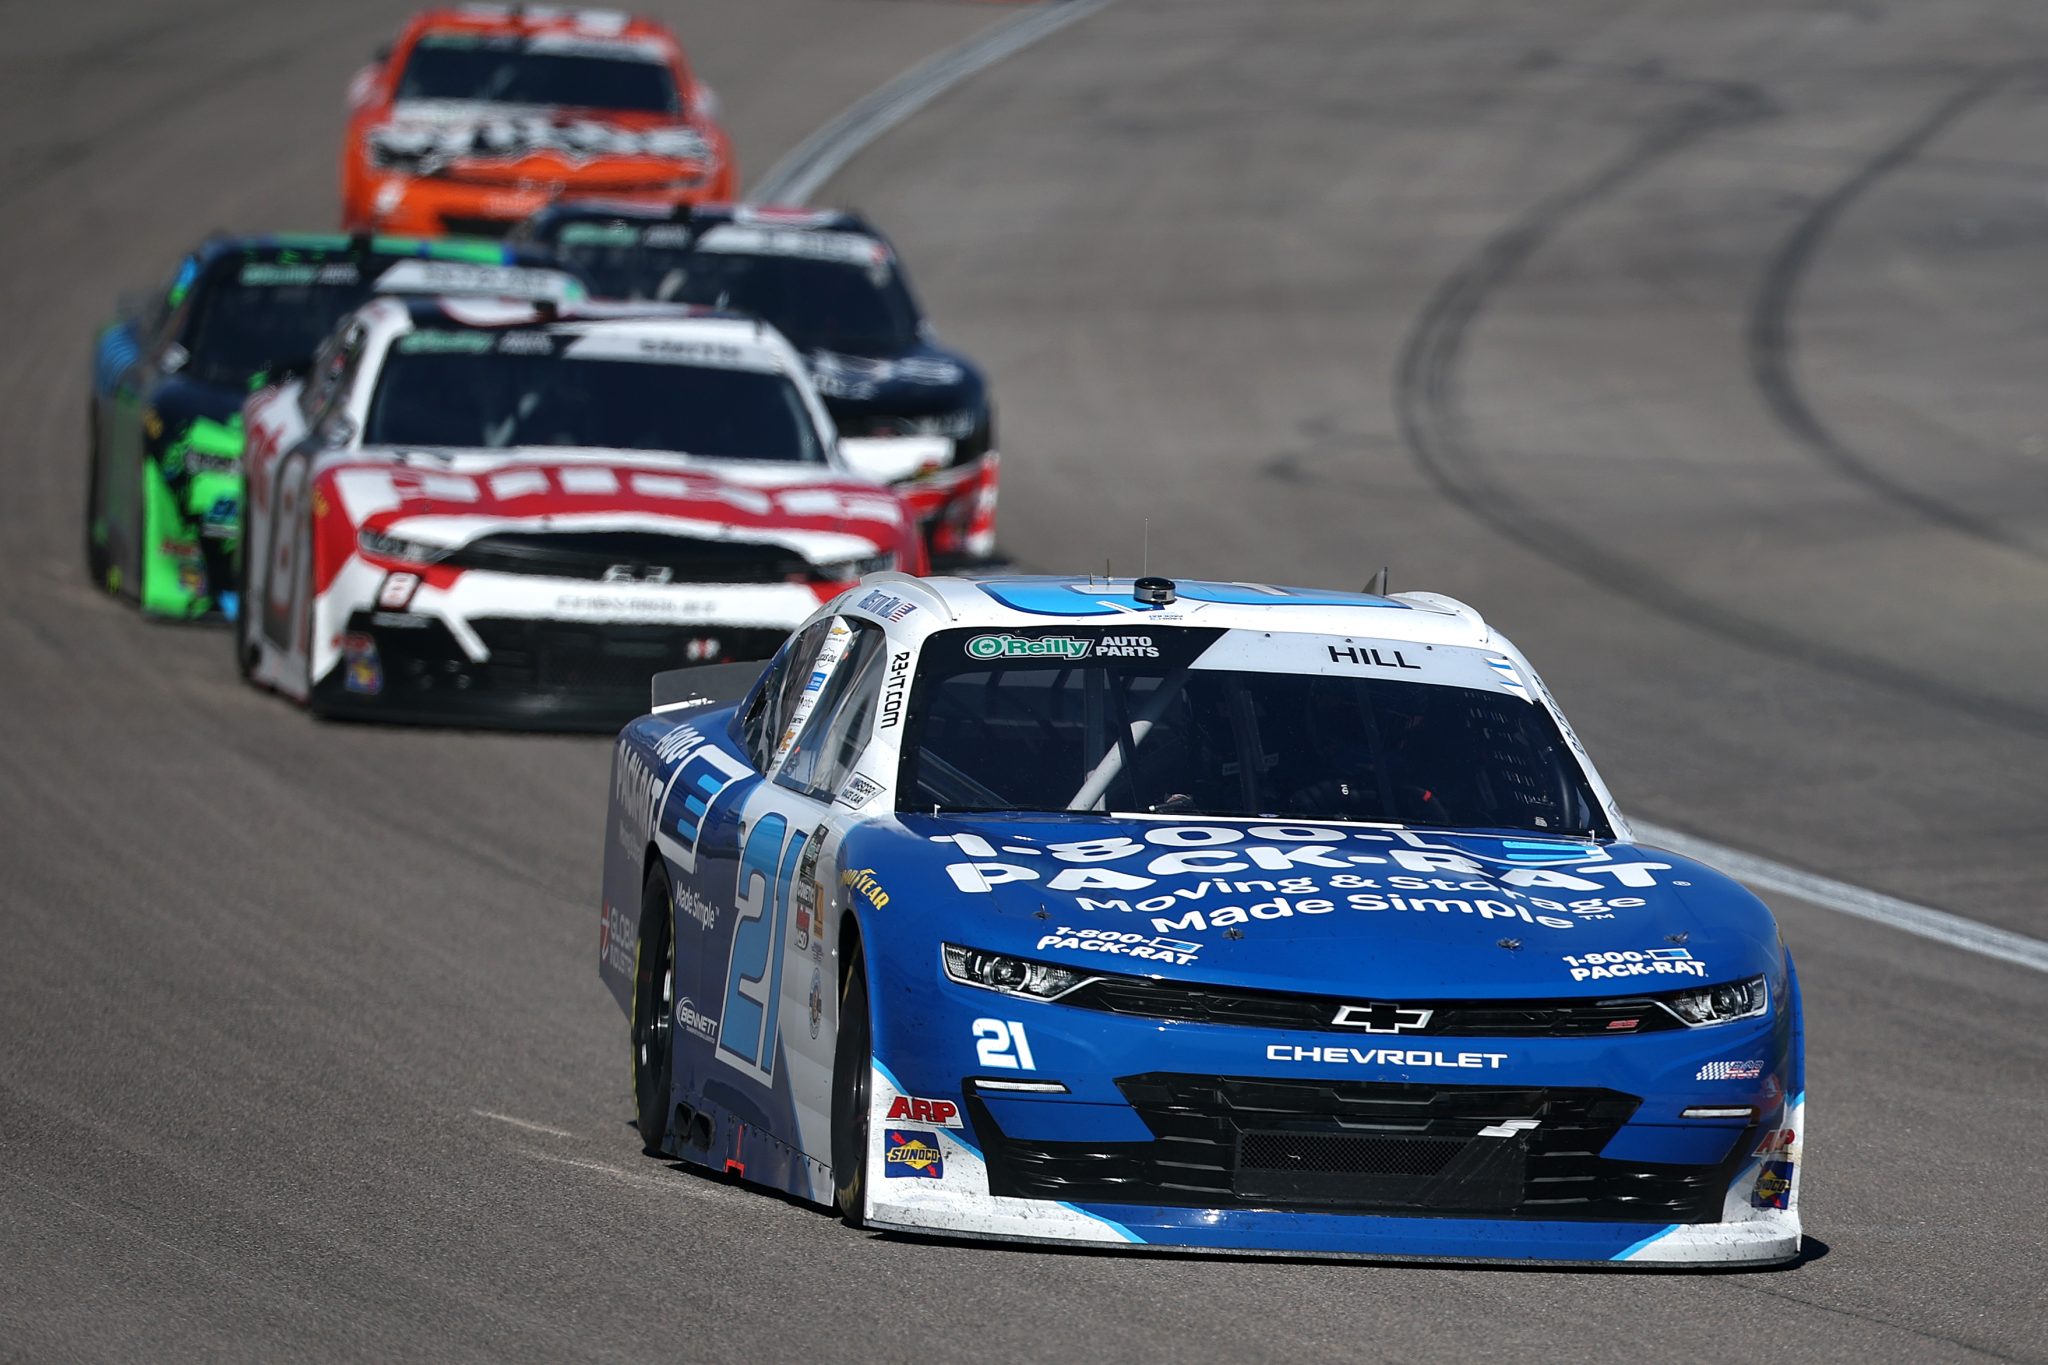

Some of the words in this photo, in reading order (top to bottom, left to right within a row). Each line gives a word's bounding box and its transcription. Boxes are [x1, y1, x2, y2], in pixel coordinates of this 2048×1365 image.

[969, 634, 1091, 659] O'Reilly
[1095, 646, 1160, 658] PARTS
[1101, 636, 1152, 647] AUTO
[1327, 645, 1422, 669] HILL
[675, 880, 694, 914] Made
[692, 892, 715, 931] Simple
[1075, 876, 1321, 913] Moving
[1329, 874, 1382, 890] &
[1387, 875, 1647, 914] Storage
[1150, 897, 1335, 934] Made
[1056, 926, 1154, 946] 1-800-
[715, 811, 809, 1088] 21
[1036, 935, 1200, 966] PACK-RAT
[1562, 950, 1651, 967] 1-800-
[1569, 960, 1704, 982] PACK-RAT
[680, 1006, 718, 1037] BENNETT
[971, 1017, 1037, 1071] 21
[1266, 1044, 1509, 1069] CHEVROLET
[886, 1096, 957, 1124] ARP
[889, 1148, 938, 1161] SUNOCO
